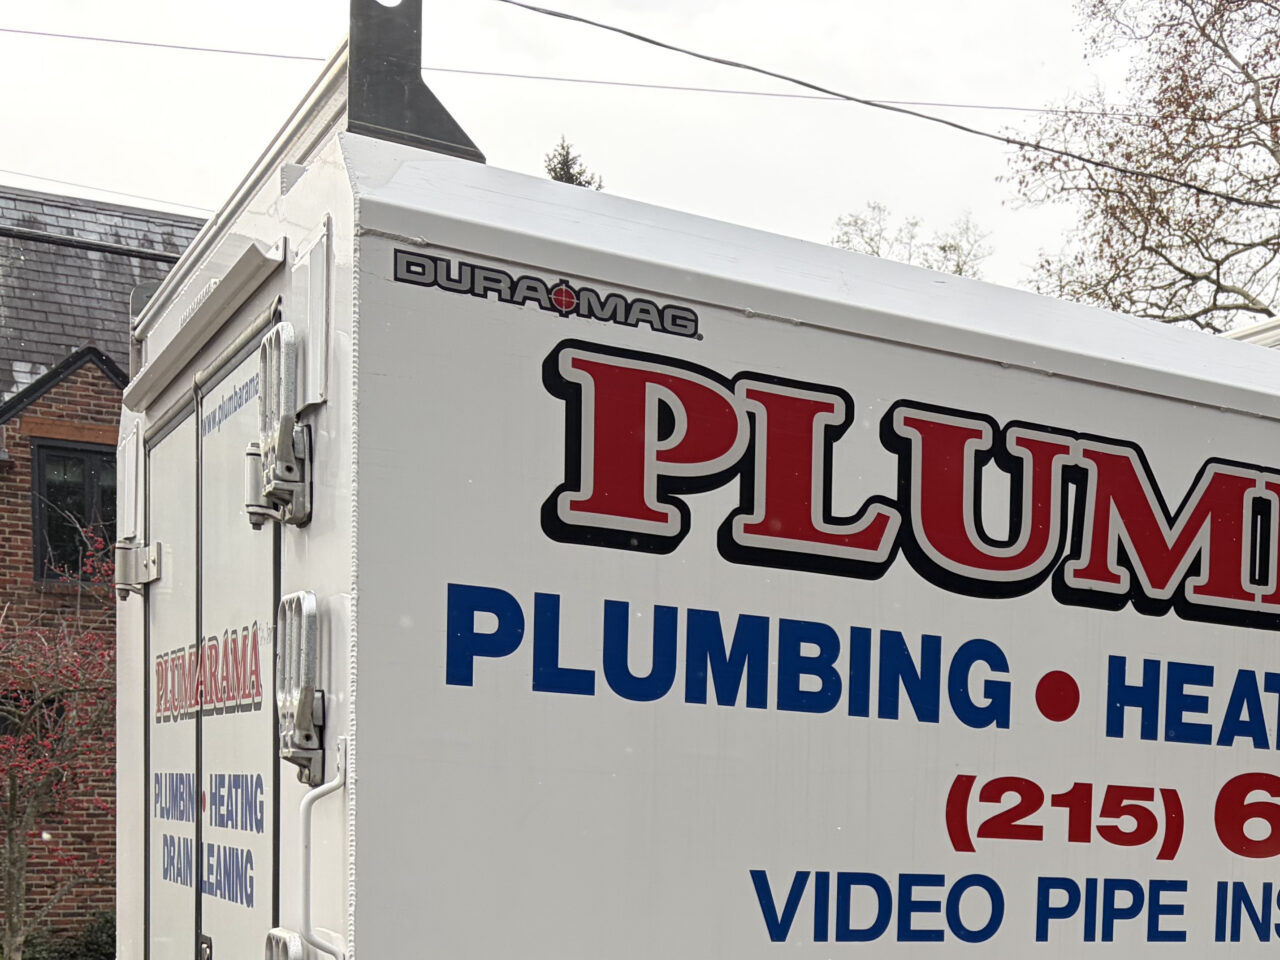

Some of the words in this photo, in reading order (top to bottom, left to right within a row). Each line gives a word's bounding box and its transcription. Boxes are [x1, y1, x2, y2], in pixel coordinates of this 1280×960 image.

[155, 620, 263, 724] PLUMARAMA
[445, 583, 1012, 729] PLUMBING
[154, 772, 195, 823] PLUMBIN
[209, 773, 265, 834] HEATING
[945, 774, 1185, 861] (215)
[162, 834, 193, 888] DRAIN
[200, 841, 255, 909] LEANING
[749, 870, 1005, 943] VIDEO
[1035, 877, 1188, 942] PIPE
